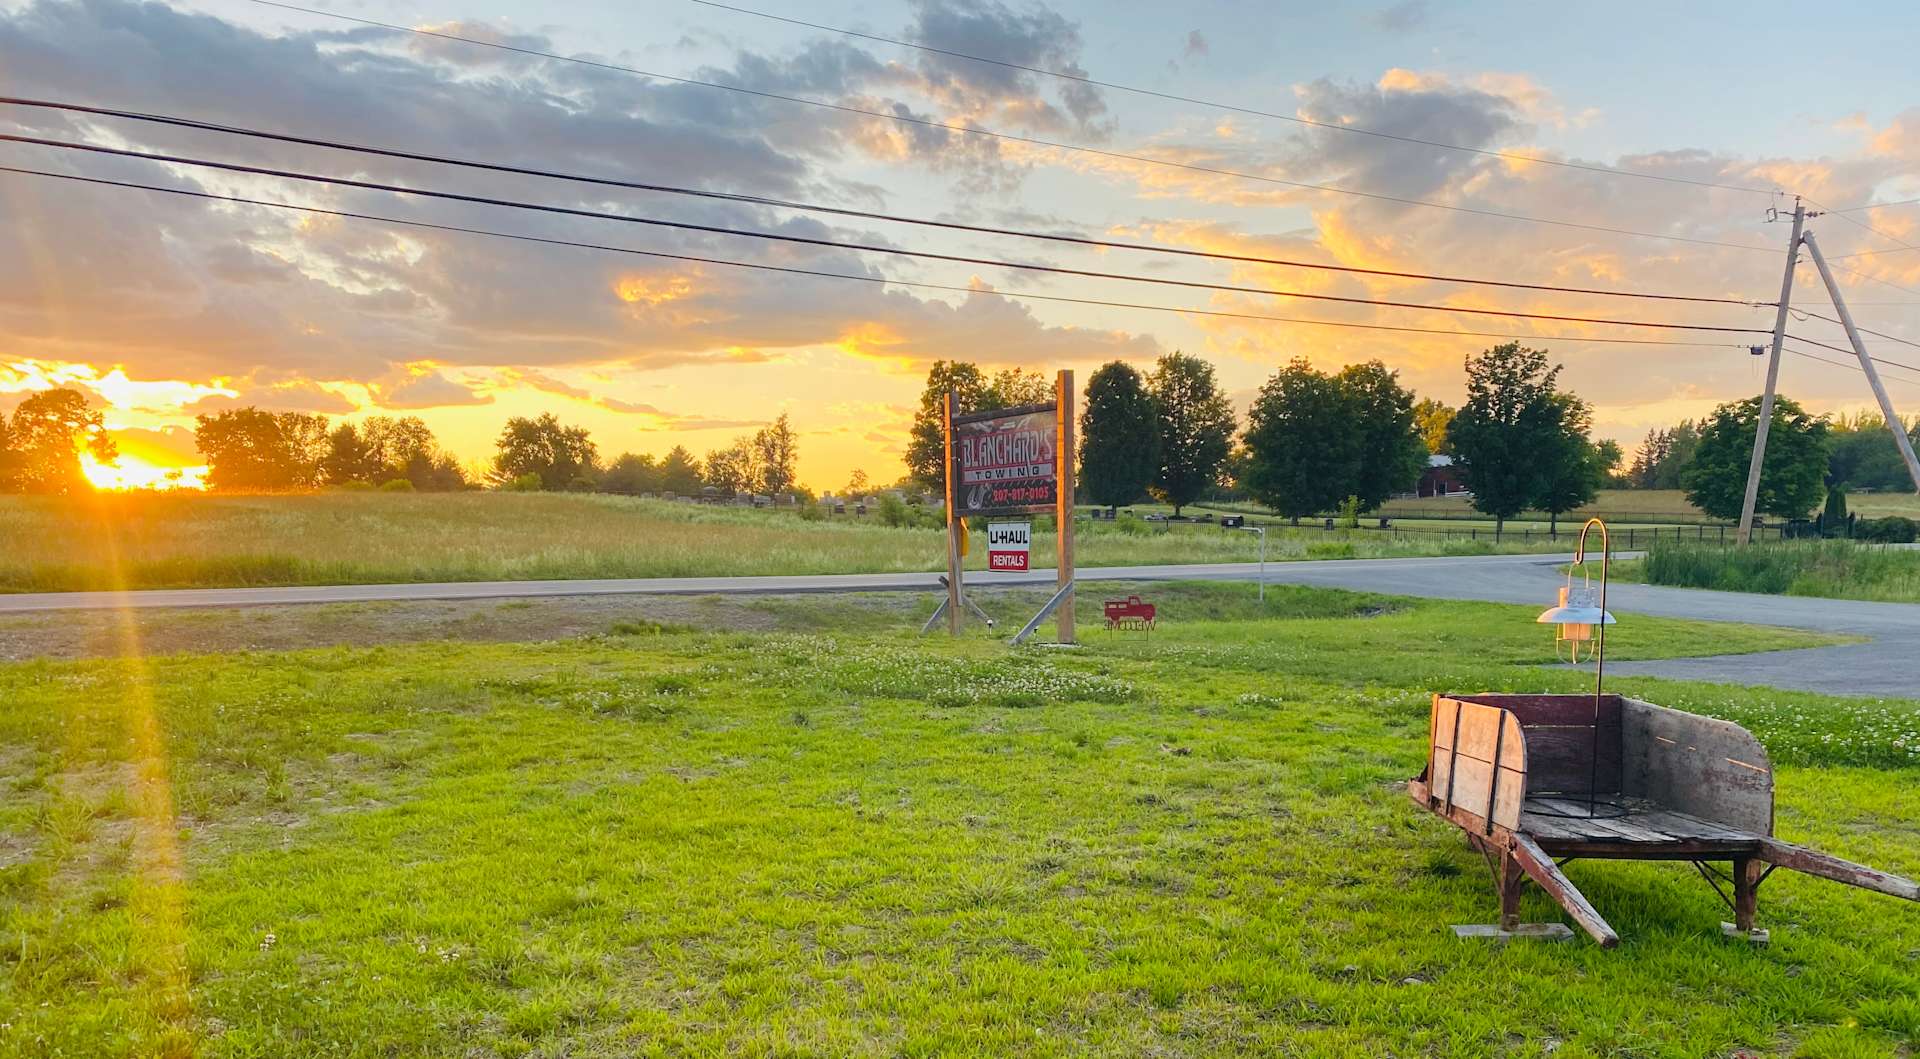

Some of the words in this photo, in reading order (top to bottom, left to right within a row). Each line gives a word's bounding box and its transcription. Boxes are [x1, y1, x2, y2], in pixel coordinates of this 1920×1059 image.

[963, 430, 1052, 467] BLANCHARD'S
[975, 466, 1040, 480] TOWING
[990, 530, 1028, 544] U-HAUL
[992, 554, 1025, 567] RENTALS
